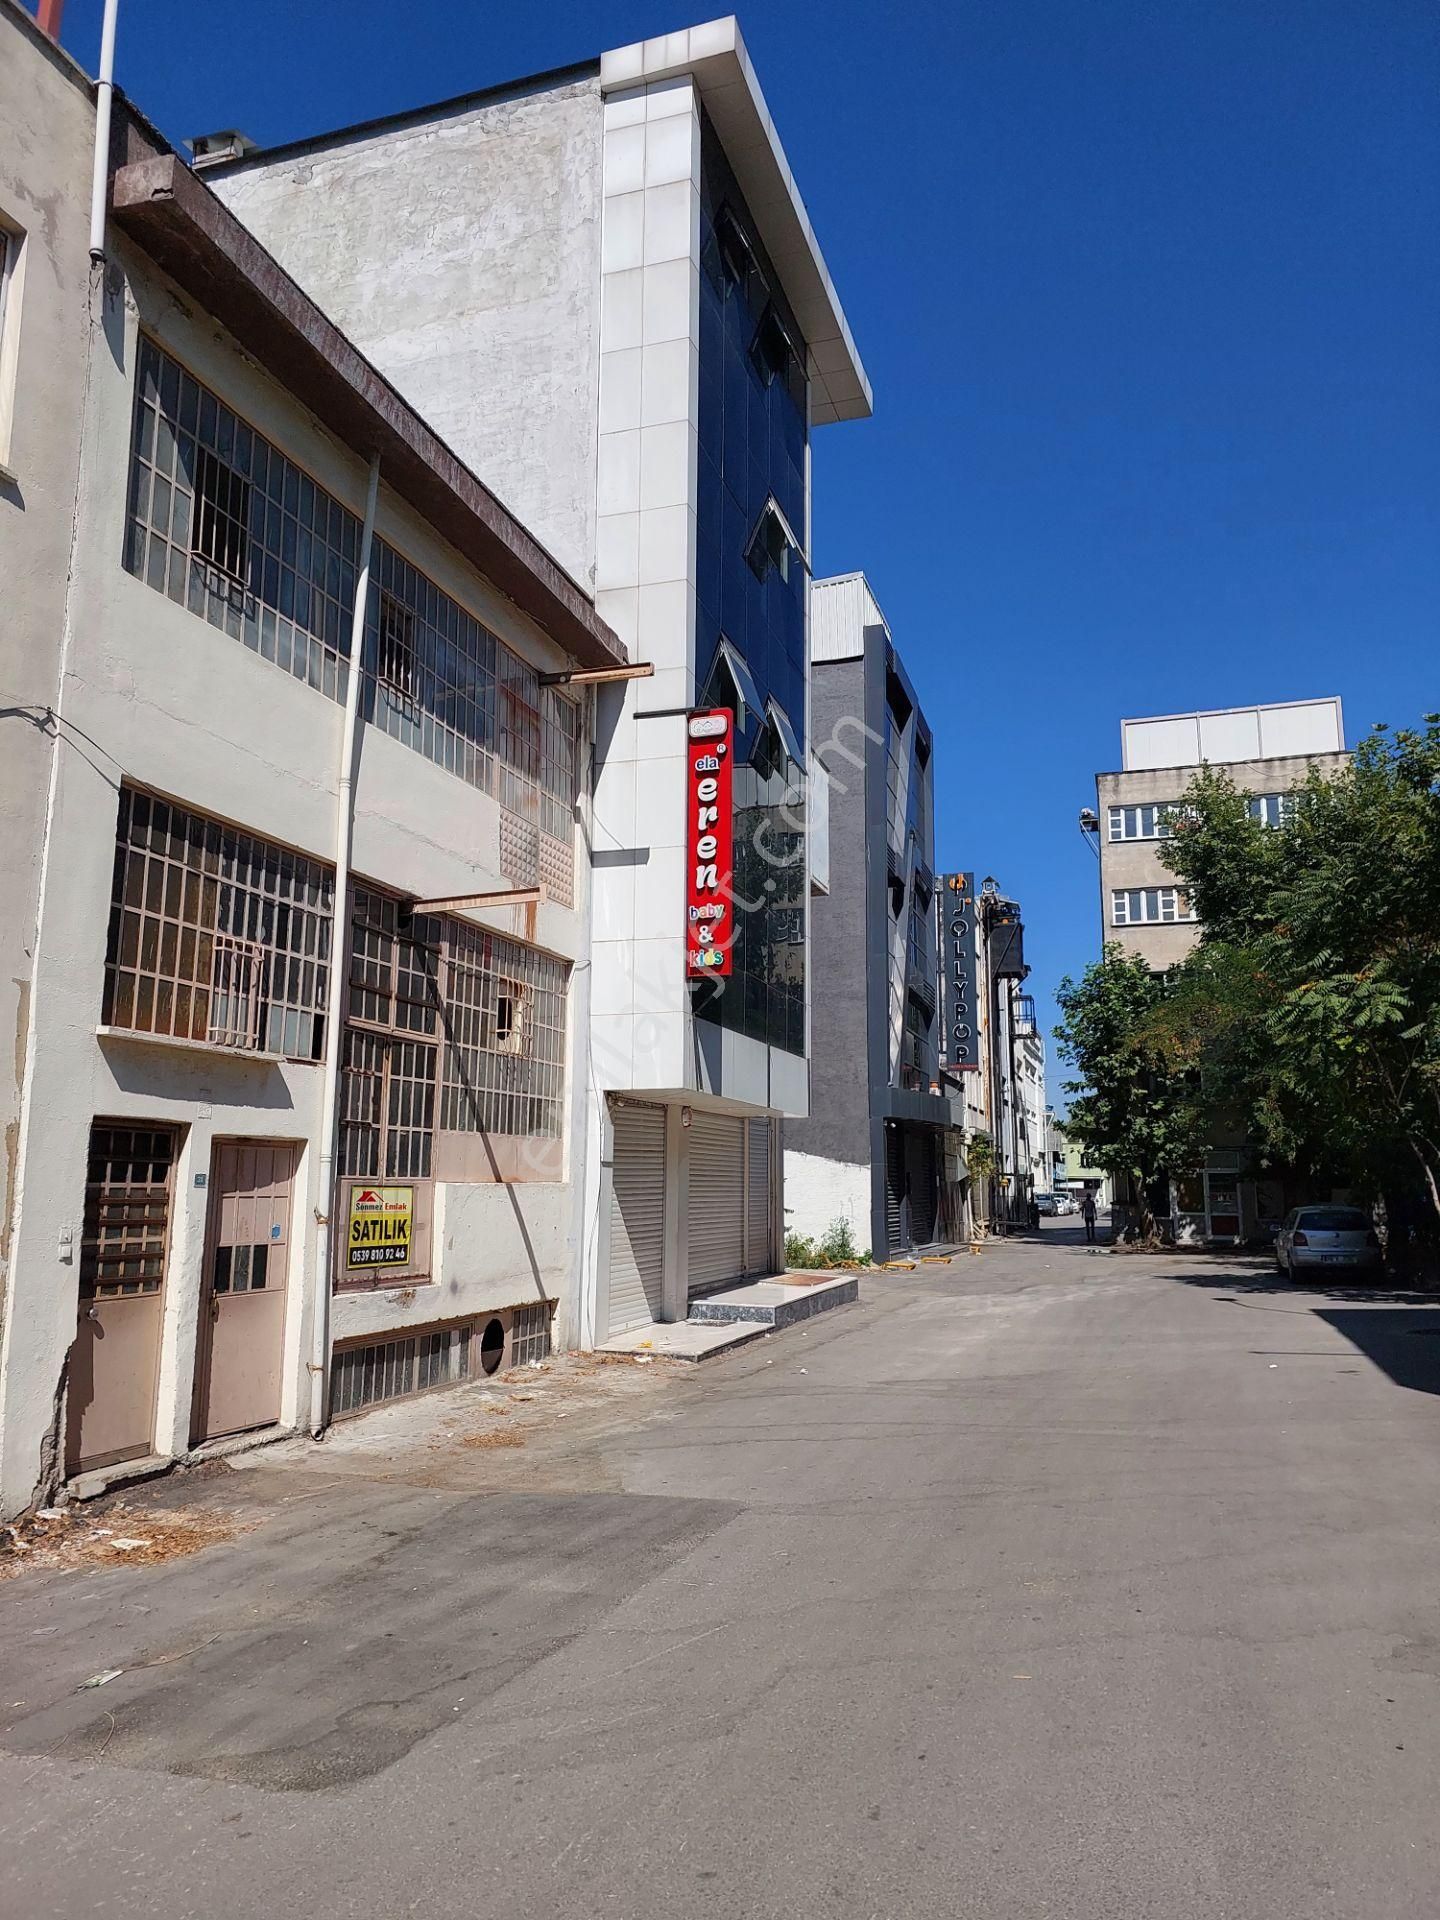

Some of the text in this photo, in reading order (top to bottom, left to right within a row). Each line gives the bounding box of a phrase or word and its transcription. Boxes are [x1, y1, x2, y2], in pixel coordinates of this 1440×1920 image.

[695, 755, 719, 771] ela
[696, 777, 718, 889] eren
[690, 903, 724, 920] baby
[698, 925, 714, 944] &
[690, 948, 723, 968] kids
[384, 1202, 407, 1211] Emlak
[352, 1219, 408, 1241] SATILIK
[352, 1250, 370, 1262] 0539
[370, 1249, 384, 1261] 810
